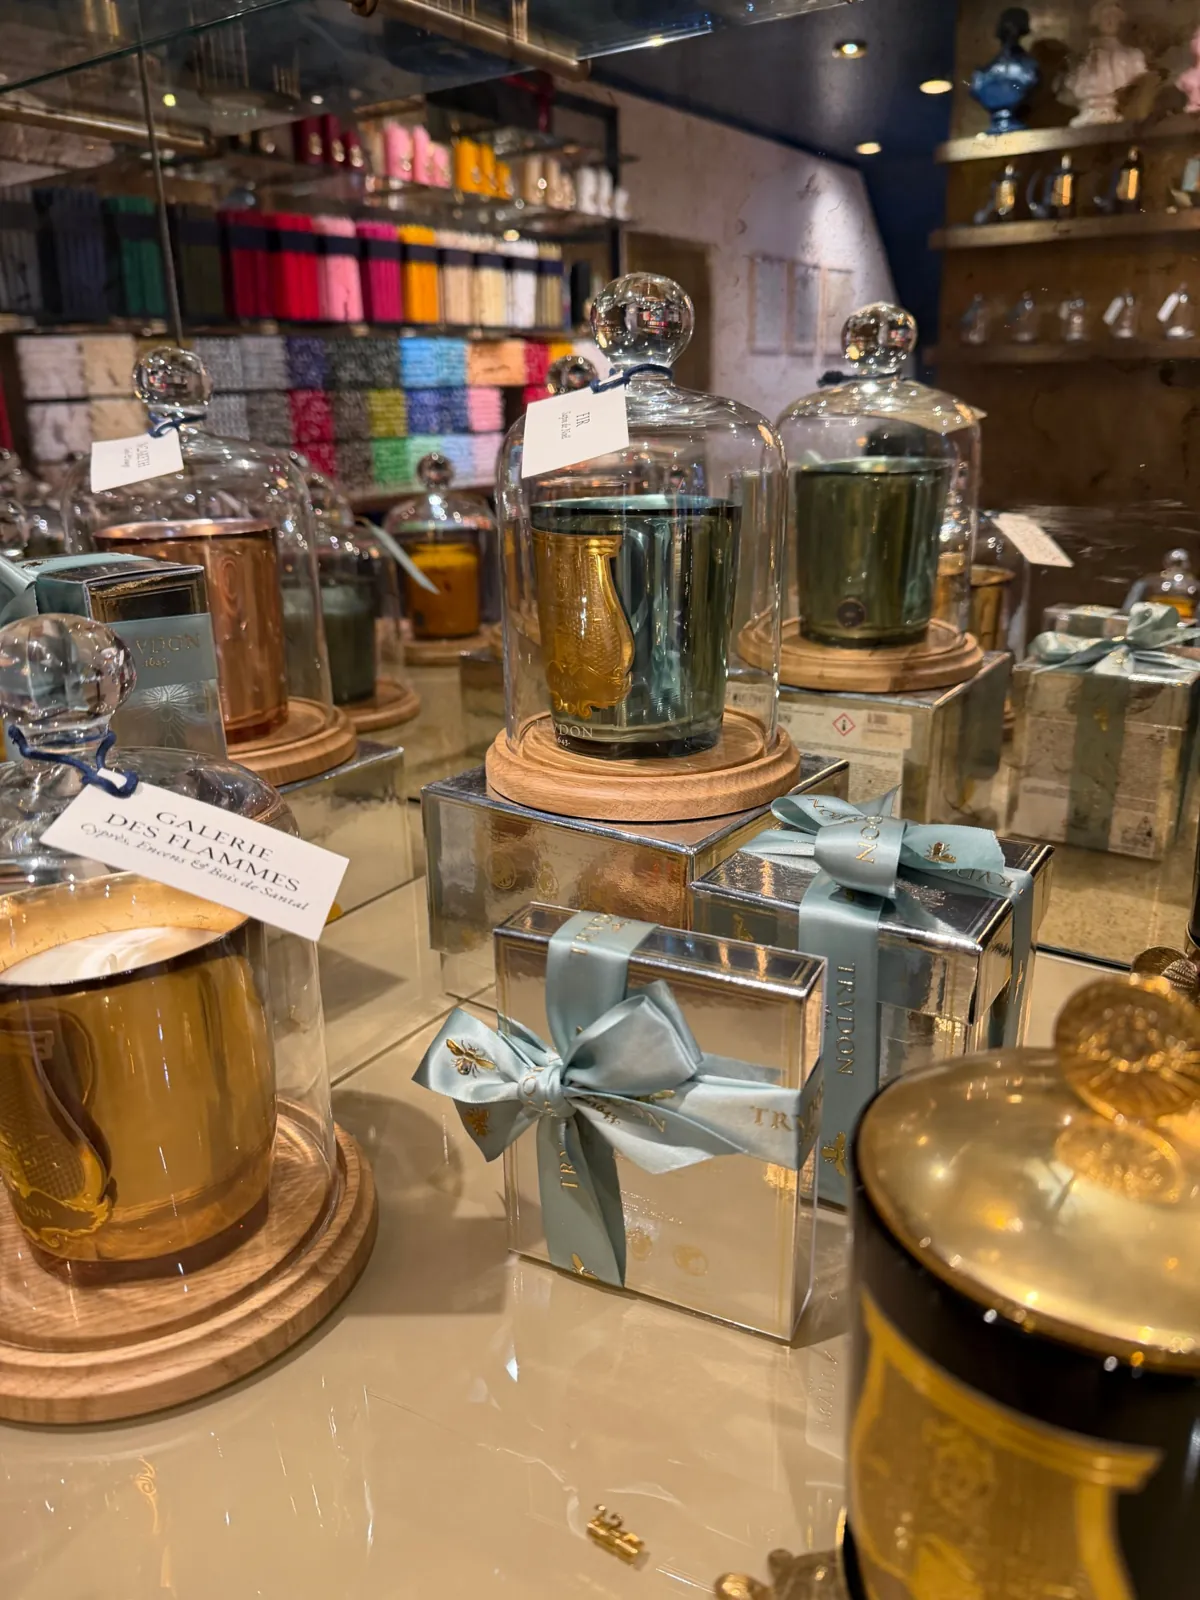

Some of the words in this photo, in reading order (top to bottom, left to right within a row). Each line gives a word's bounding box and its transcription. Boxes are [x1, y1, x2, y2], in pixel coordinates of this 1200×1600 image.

[576, 411, 591, 428] FIR
[105, 813, 160, 838] DES
[168, 833, 300, 892] FLAMMES
[156, 811, 274, 862] GALERIE
[136, 840, 185, 864] Encens
[191, 859, 209, 870] &
[209, 867, 238, 884] Bois
[240, 880, 259, 891] de
[260, 887, 310, 911] Santal
[836, 960, 856, 1077] TRVDON
